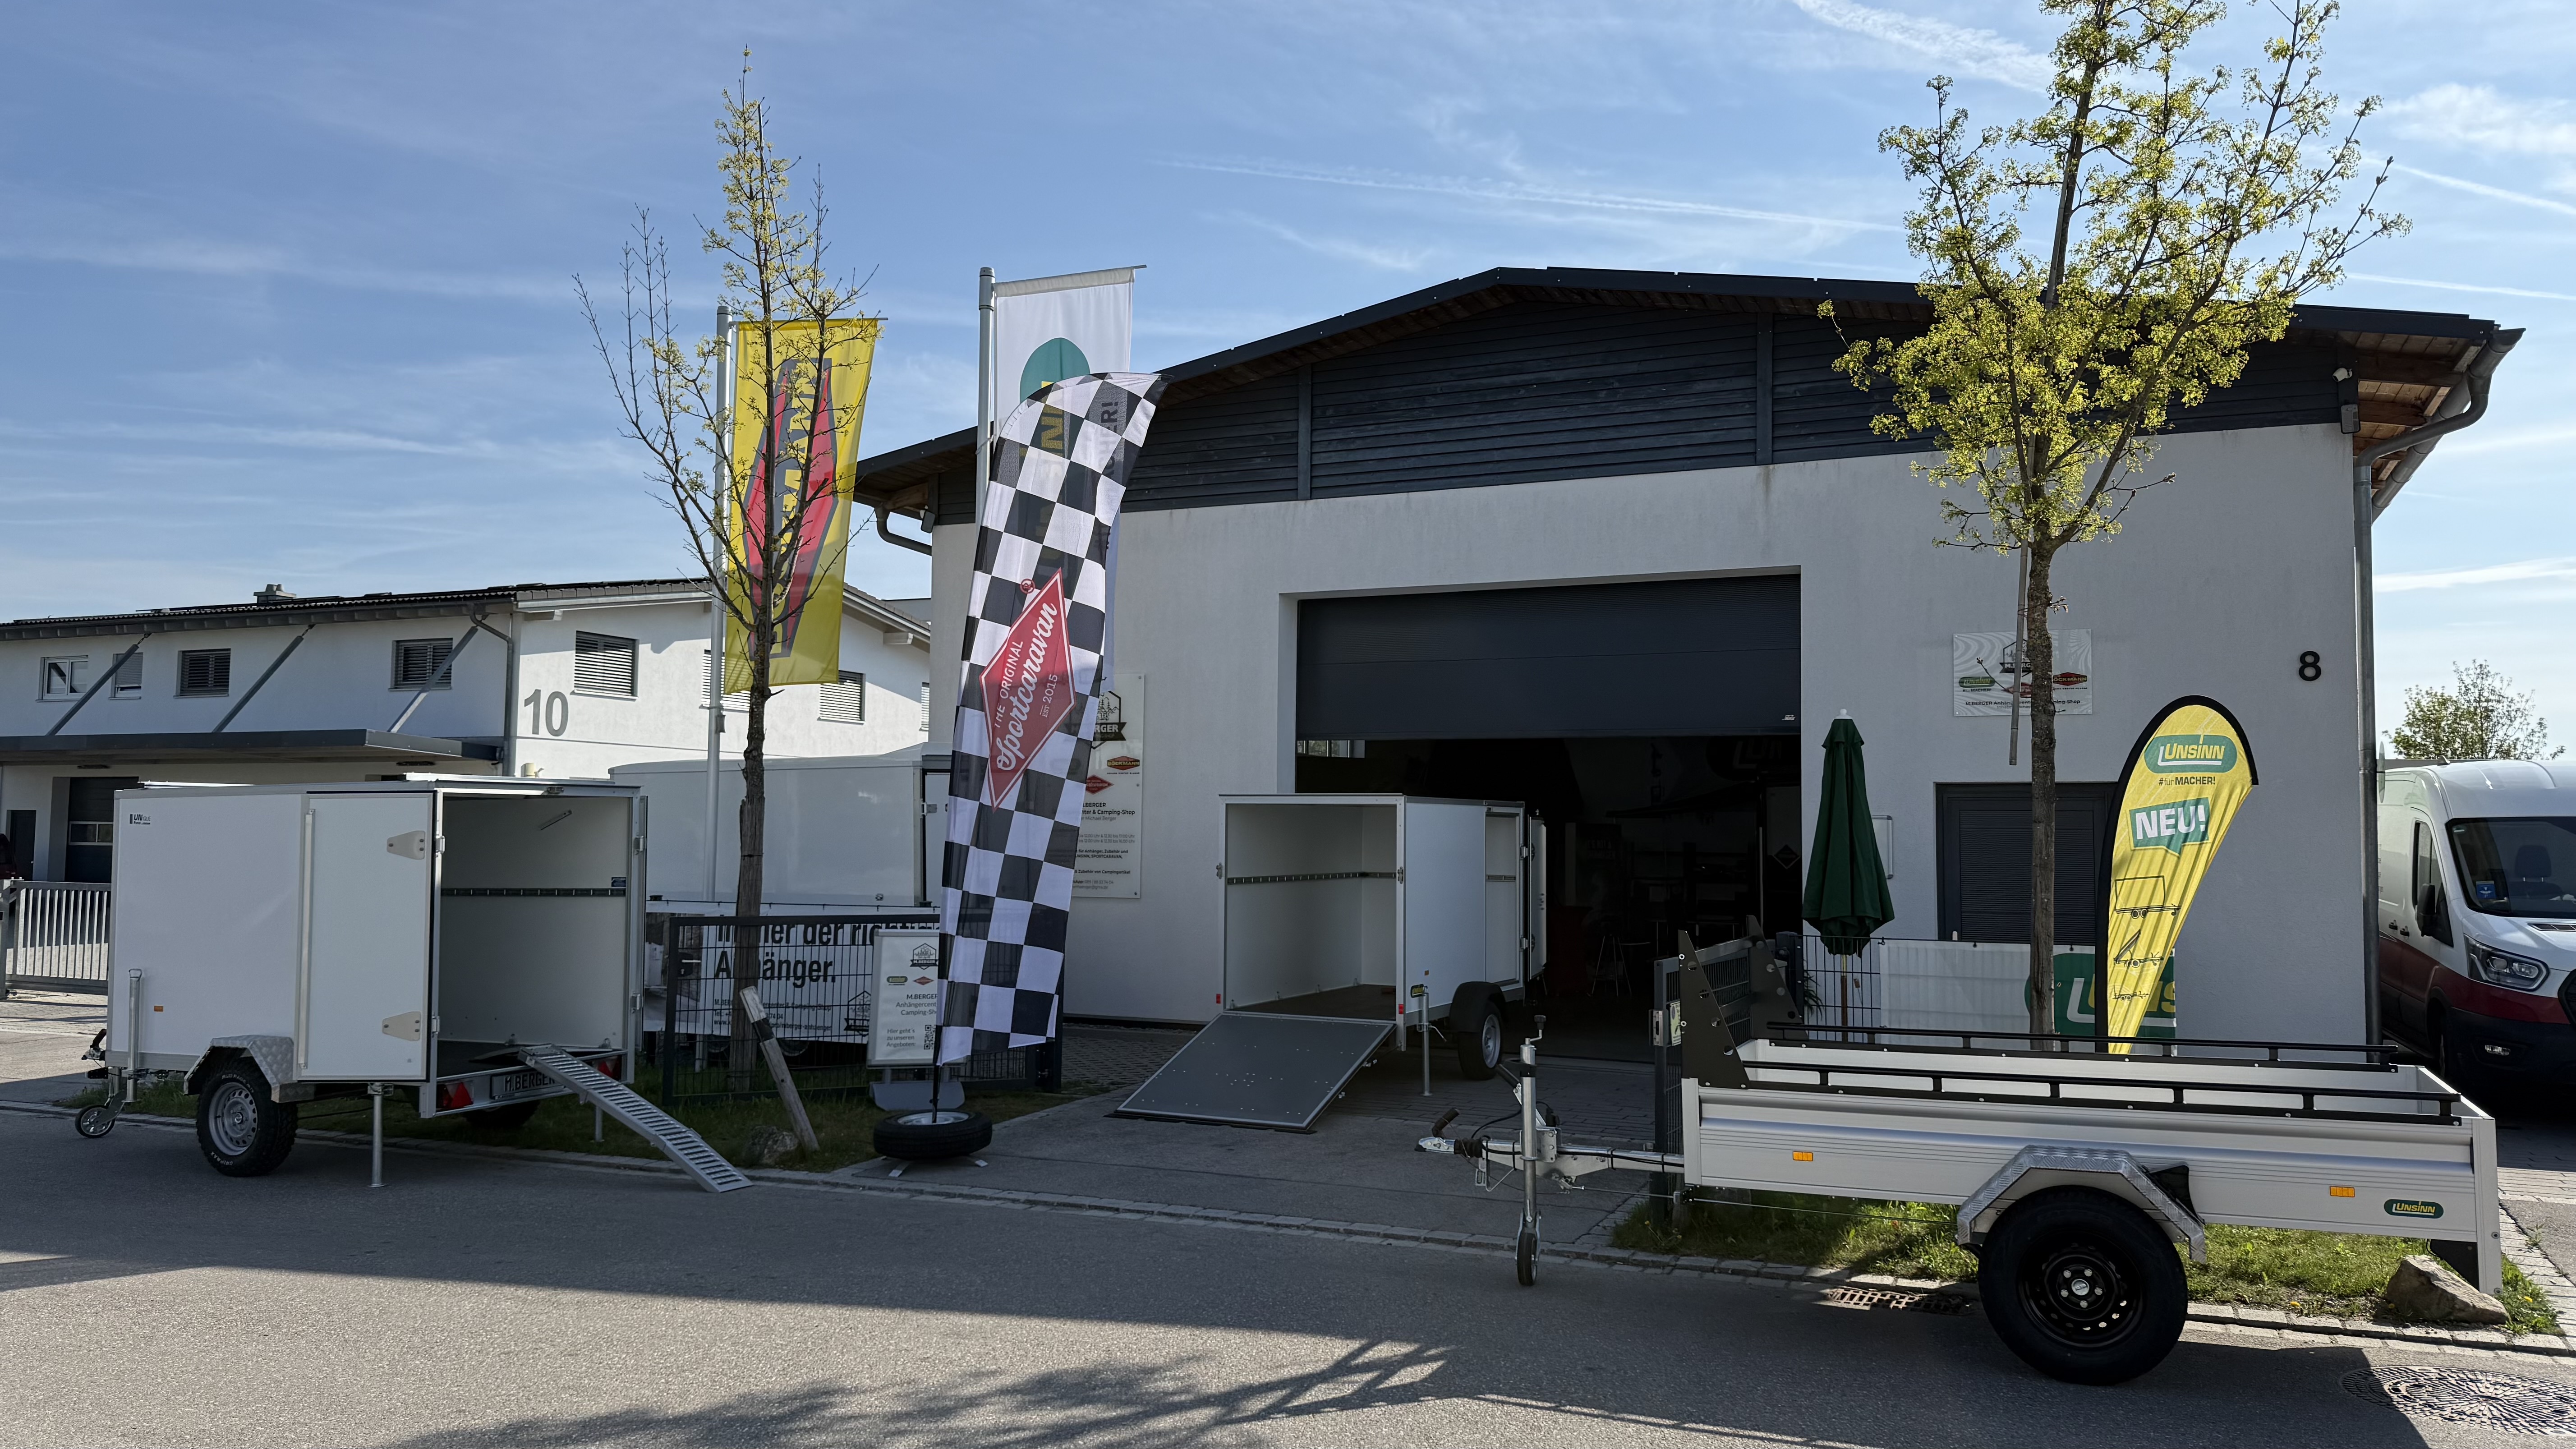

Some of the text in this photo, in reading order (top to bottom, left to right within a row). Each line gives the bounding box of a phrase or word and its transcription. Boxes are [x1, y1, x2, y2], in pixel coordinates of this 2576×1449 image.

[2299, 651, 2321, 681] 8
[994, 640, 1023, 728] THE ORIGINAL
[996, 602, 1058, 771] Sportcaravan
[1043, 674, 1058, 703] 2015
[524, 689, 569, 737] 10
[1095, 724, 1119, 733] RGER
[2164, 740, 2225, 761] UNSINN
[2158, 776, 2216, 786] #für MACHER!
[2135, 805, 2206, 840] NEU!
[804, 924, 845, 945] der
[714, 951, 836, 988] Aänger.
[2396, 1201, 2435, 1214] UNSINN
